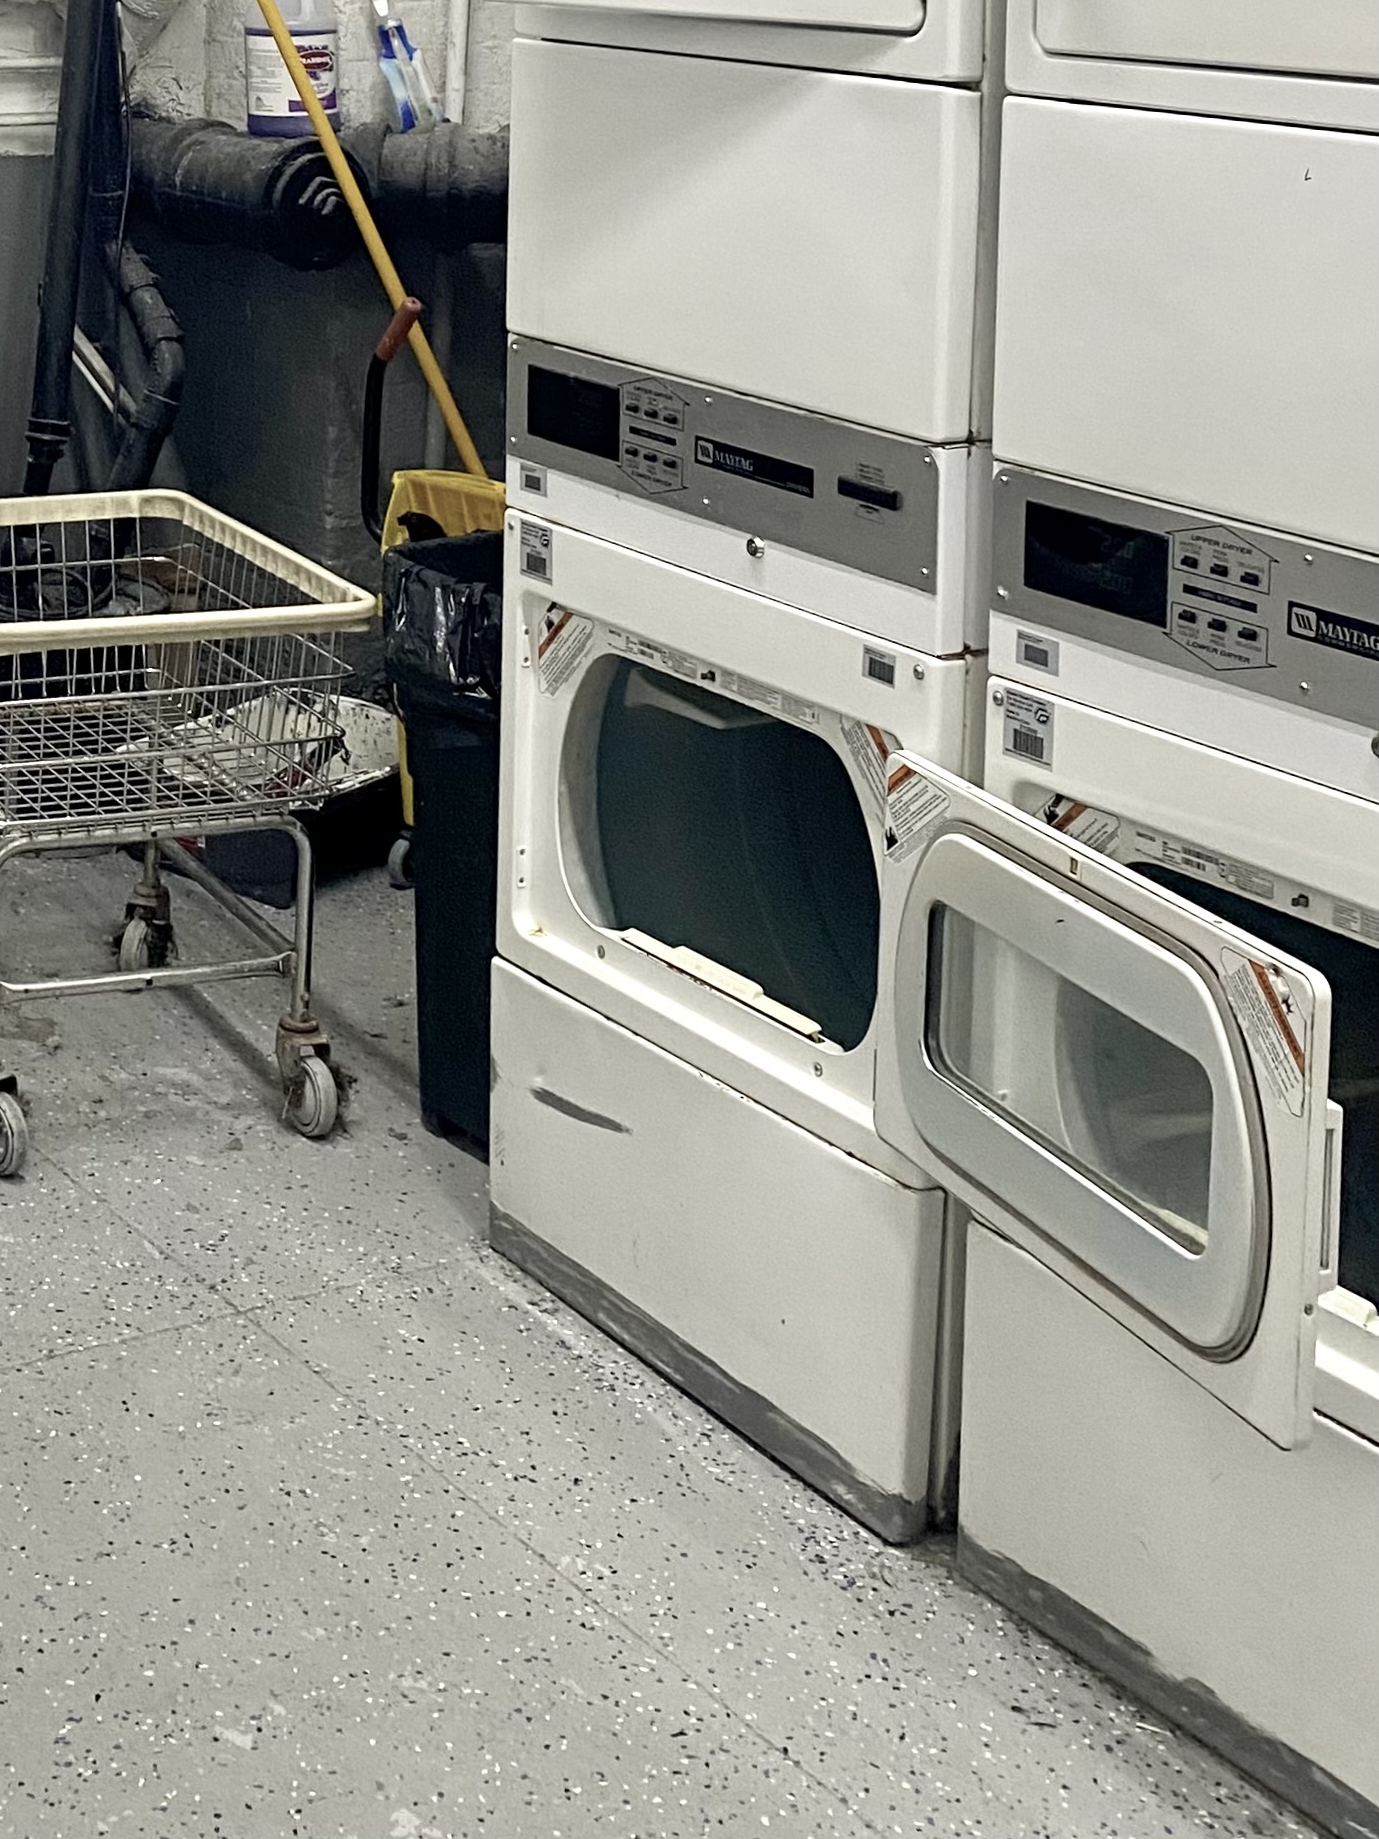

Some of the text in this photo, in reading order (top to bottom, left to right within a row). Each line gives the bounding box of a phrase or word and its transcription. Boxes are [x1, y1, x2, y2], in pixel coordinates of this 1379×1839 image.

[714, 450, 754, 471] MAYTAG
[1222, 543, 1253, 555] DRYER
[1186, 640, 1250, 664] LOWER DRYER
